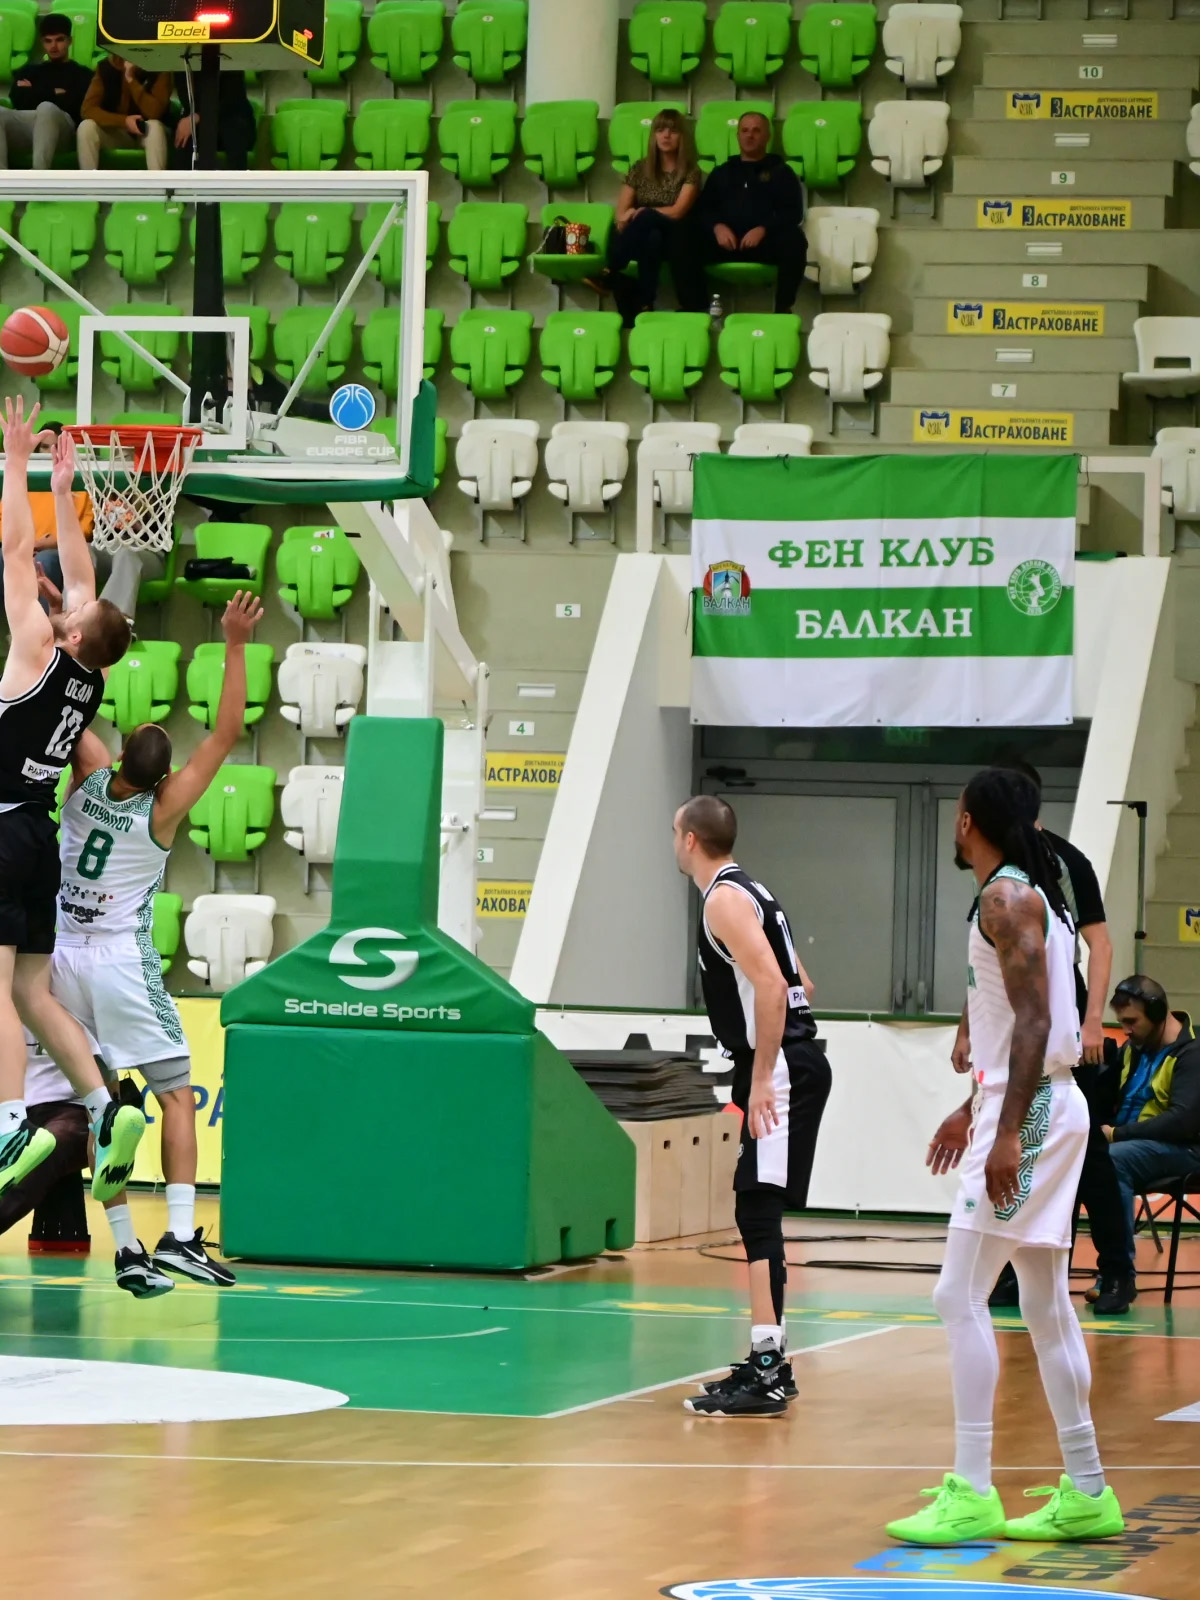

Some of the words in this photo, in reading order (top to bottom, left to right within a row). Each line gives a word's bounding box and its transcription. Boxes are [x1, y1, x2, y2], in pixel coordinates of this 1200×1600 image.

[161, 23, 207, 37] Bodet
[1083, 66, 1098, 78] 10
[1051, 97, 1153, 118] ЗАСТРАХОВАНЕ
[1059, 172, 1067, 183] 9
[1022, 205, 1126, 227] ЗАСТРАХОВАНЕ
[1031, 275, 1039, 286] 8
[993, 309, 1099, 332] ЗАСТРАХОВАНЕ
[1000, 385, 1008, 396] 7
[960, 417, 1068, 441] ЗАСТРАХОВАНЕ
[334, 435, 367, 444] FIBA
[306, 446, 363, 456] EUROPE
[367, 446, 396, 457] CUP
[768, 539, 863, 568] ФЕН
[880, 537, 995, 567] КЛУБ
[564, 606, 572, 617] 5
[703, 597, 751, 609] БАЛКАН
[795, 608, 973, 639] БАЛКАН
[64, 677, 94, 704] DEAN
[44, 704, 84, 760] 12
[516, 723, 525, 734] 4
[487, 766, 564, 786] АСТРАХОВ
[81, 797, 134, 833] BOYANOV
[76, 828, 115, 880] 8
[477, 850, 485, 861] 3
[284, 998, 379, 1019] Schelde
[382, 1003, 462, 1023] Sports
